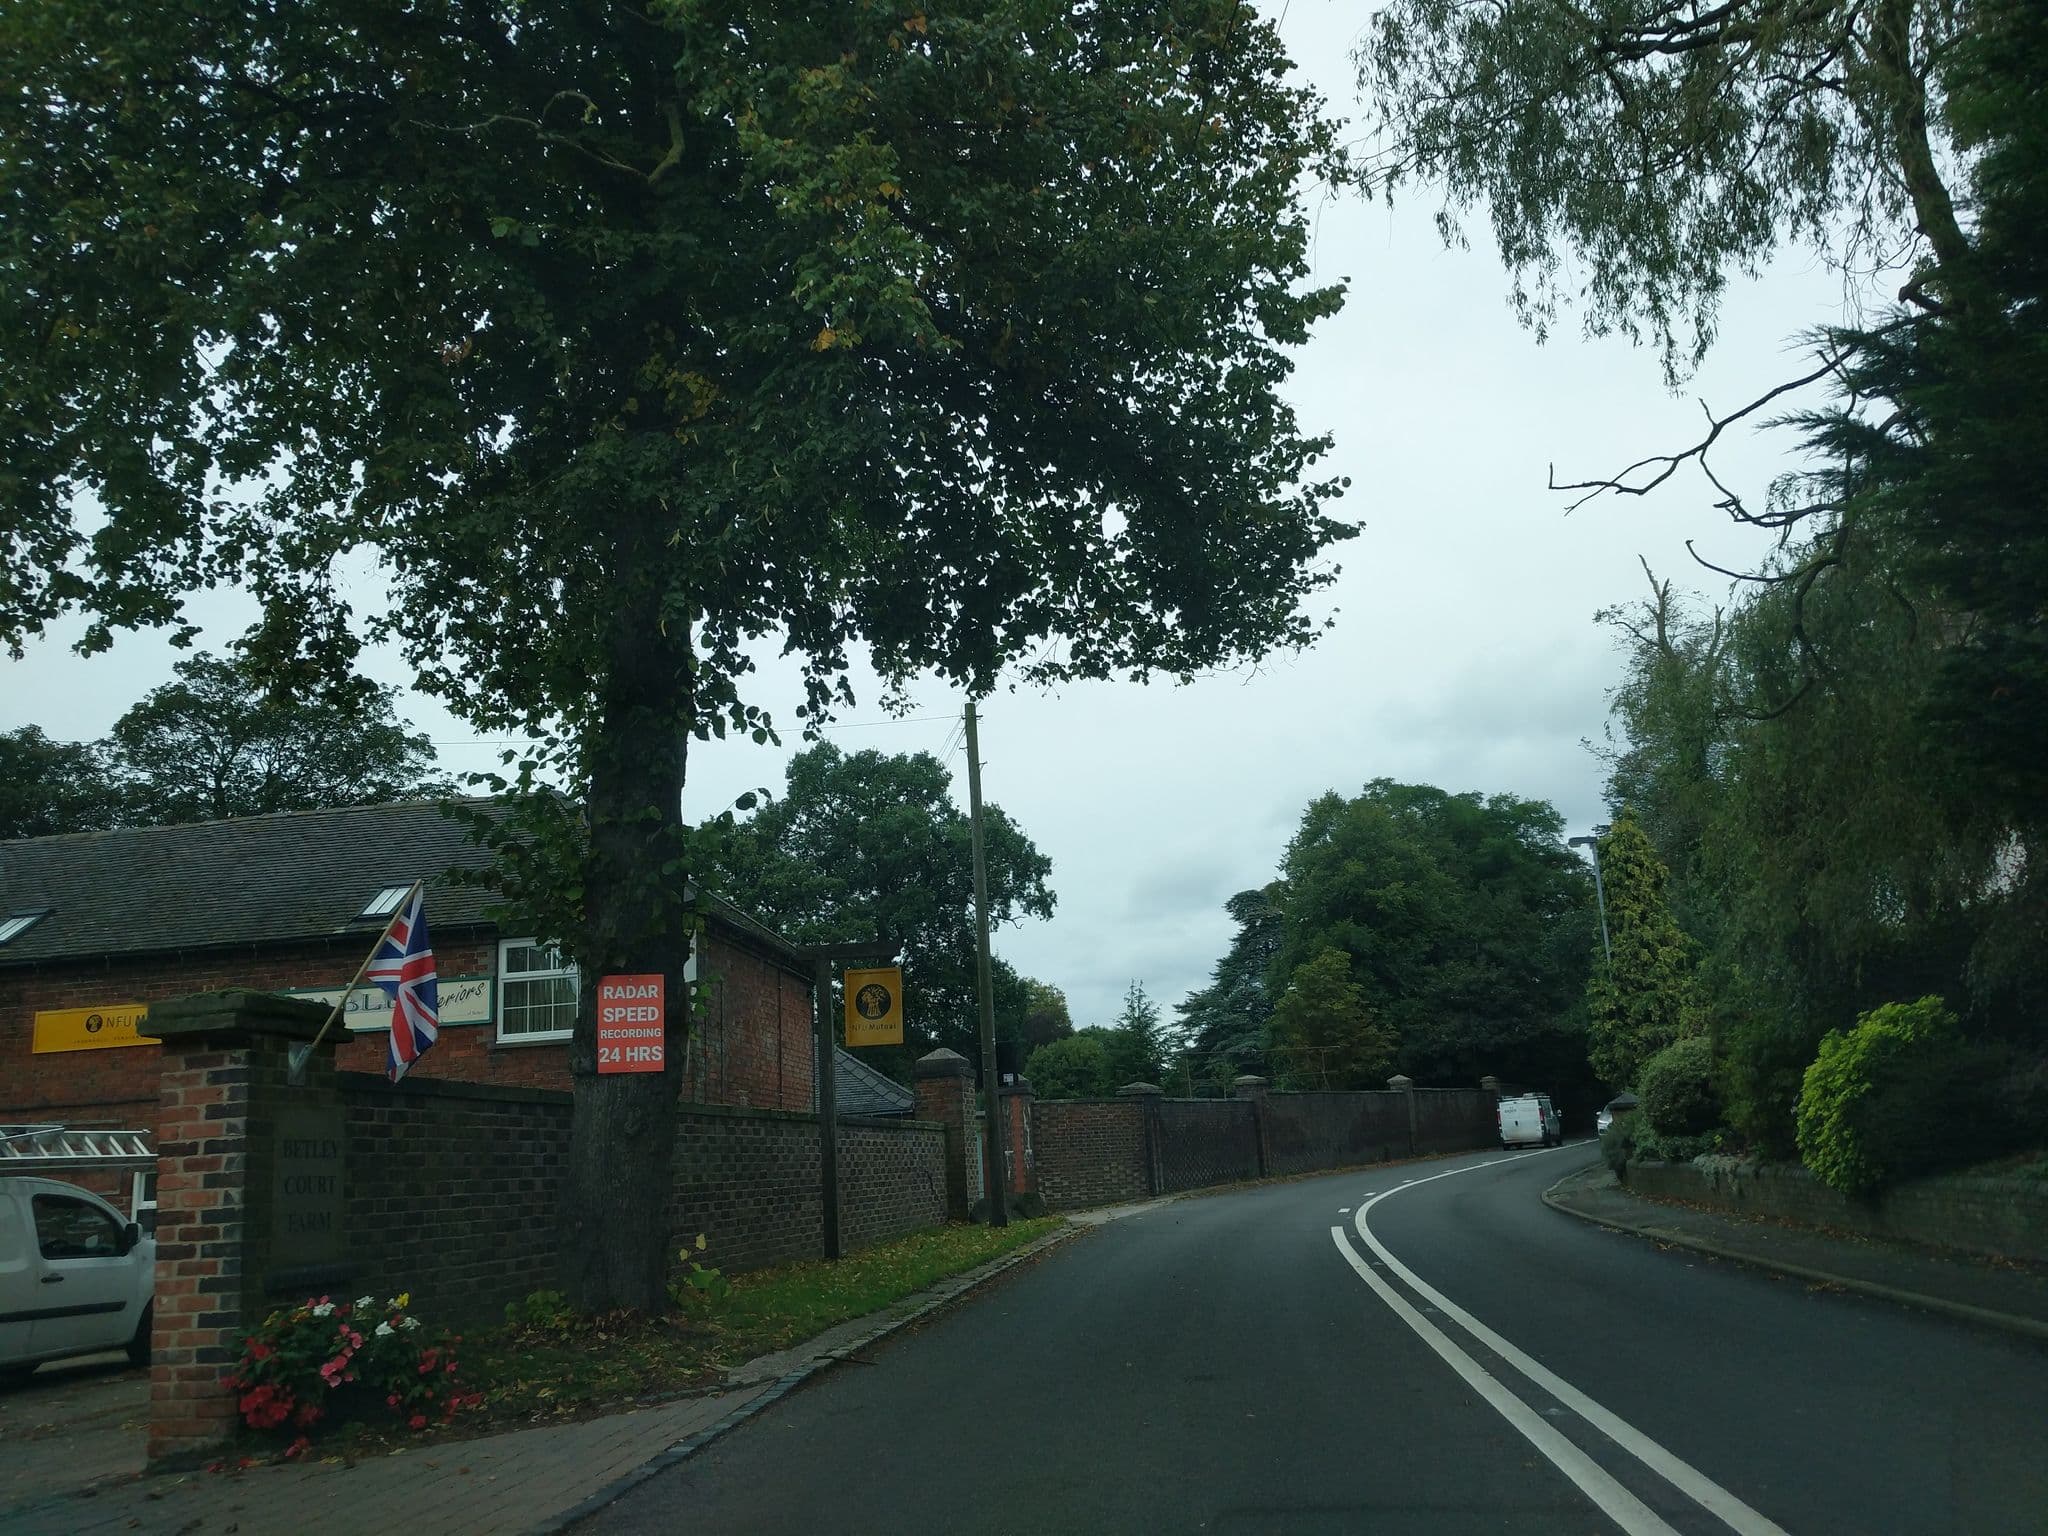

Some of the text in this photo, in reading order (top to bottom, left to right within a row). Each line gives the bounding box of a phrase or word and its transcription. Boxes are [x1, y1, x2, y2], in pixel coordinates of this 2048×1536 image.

[603, 985, 658, 999] RADAR
[105, 1016, 131, 1028] NFU
[603, 1006, 659, 1022] SPEED
[600, 1028, 661, 1039] RECORDING
[600, 1046, 663, 1063] 24 HRS
[284, 1176, 337, 1194] COURT
[288, 1212, 331, 1232] FARM
